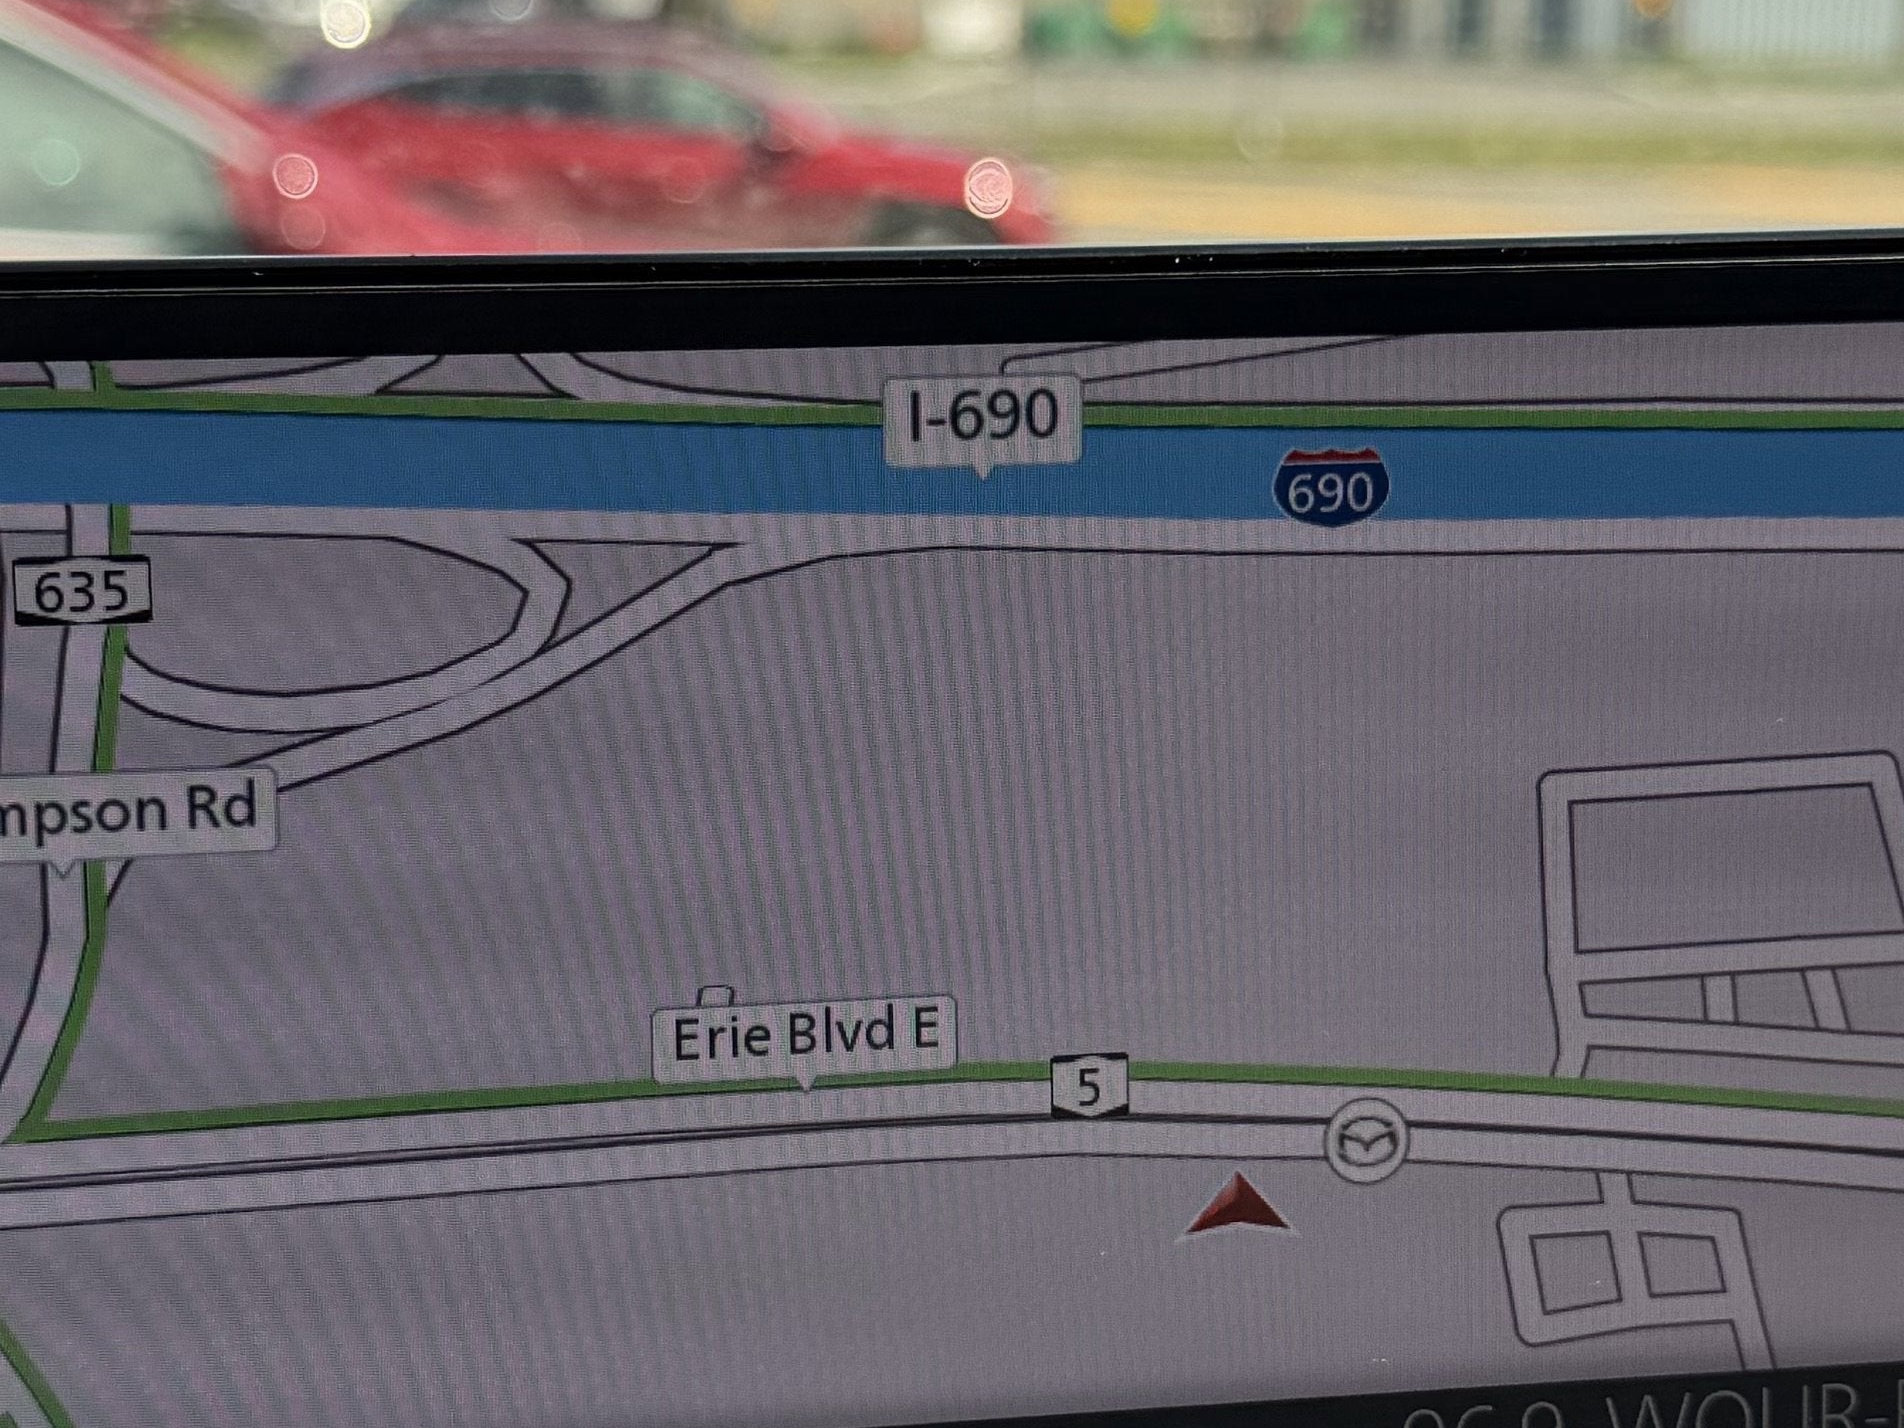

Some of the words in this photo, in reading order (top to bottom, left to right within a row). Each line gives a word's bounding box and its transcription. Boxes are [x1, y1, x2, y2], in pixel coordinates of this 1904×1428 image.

[909, 387, 1059, 443] I-690
[1288, 470, 1373, 514] 690
[34, 569, 129, 614] 635
[187, 777, 256, 830] Rd
[674, 1014, 771, 1061] Erie
[788, 1004, 895, 1055] Blvd
[913, 1006, 940, 1049] E
[1078, 1067, 1100, 1107] 5
